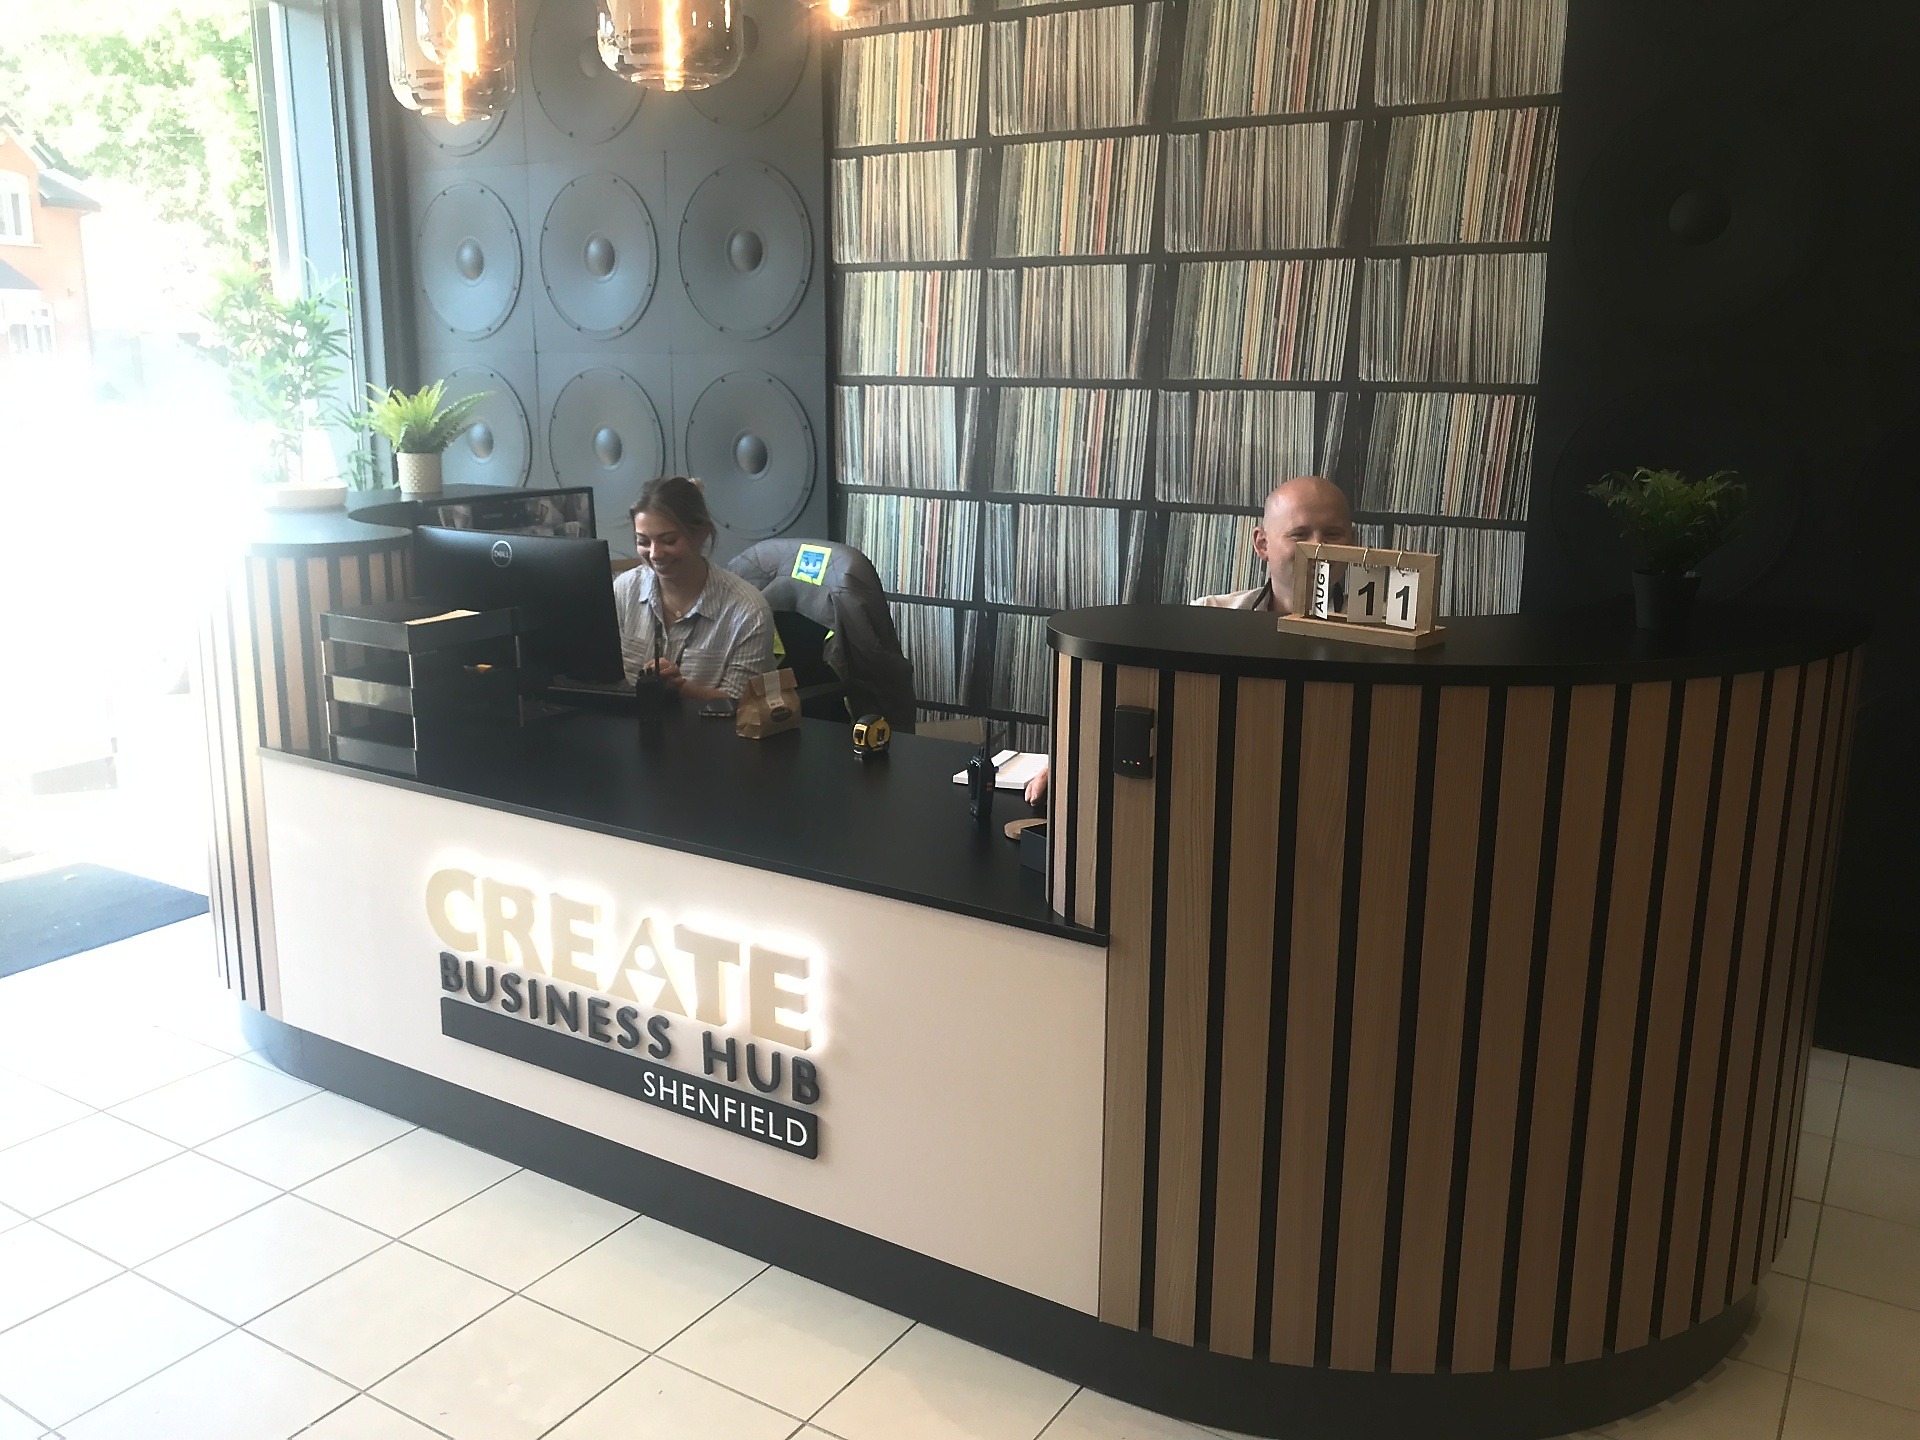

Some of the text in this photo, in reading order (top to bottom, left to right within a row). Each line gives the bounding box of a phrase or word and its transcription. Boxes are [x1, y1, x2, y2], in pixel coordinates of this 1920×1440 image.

[1314, 573, 1326, 613] AUG
[427, 868, 812, 1051] CREATE
[439, 951, 821, 1105] BUSINESS HUB
[643, 1071, 808, 1148] SHENFIELD
